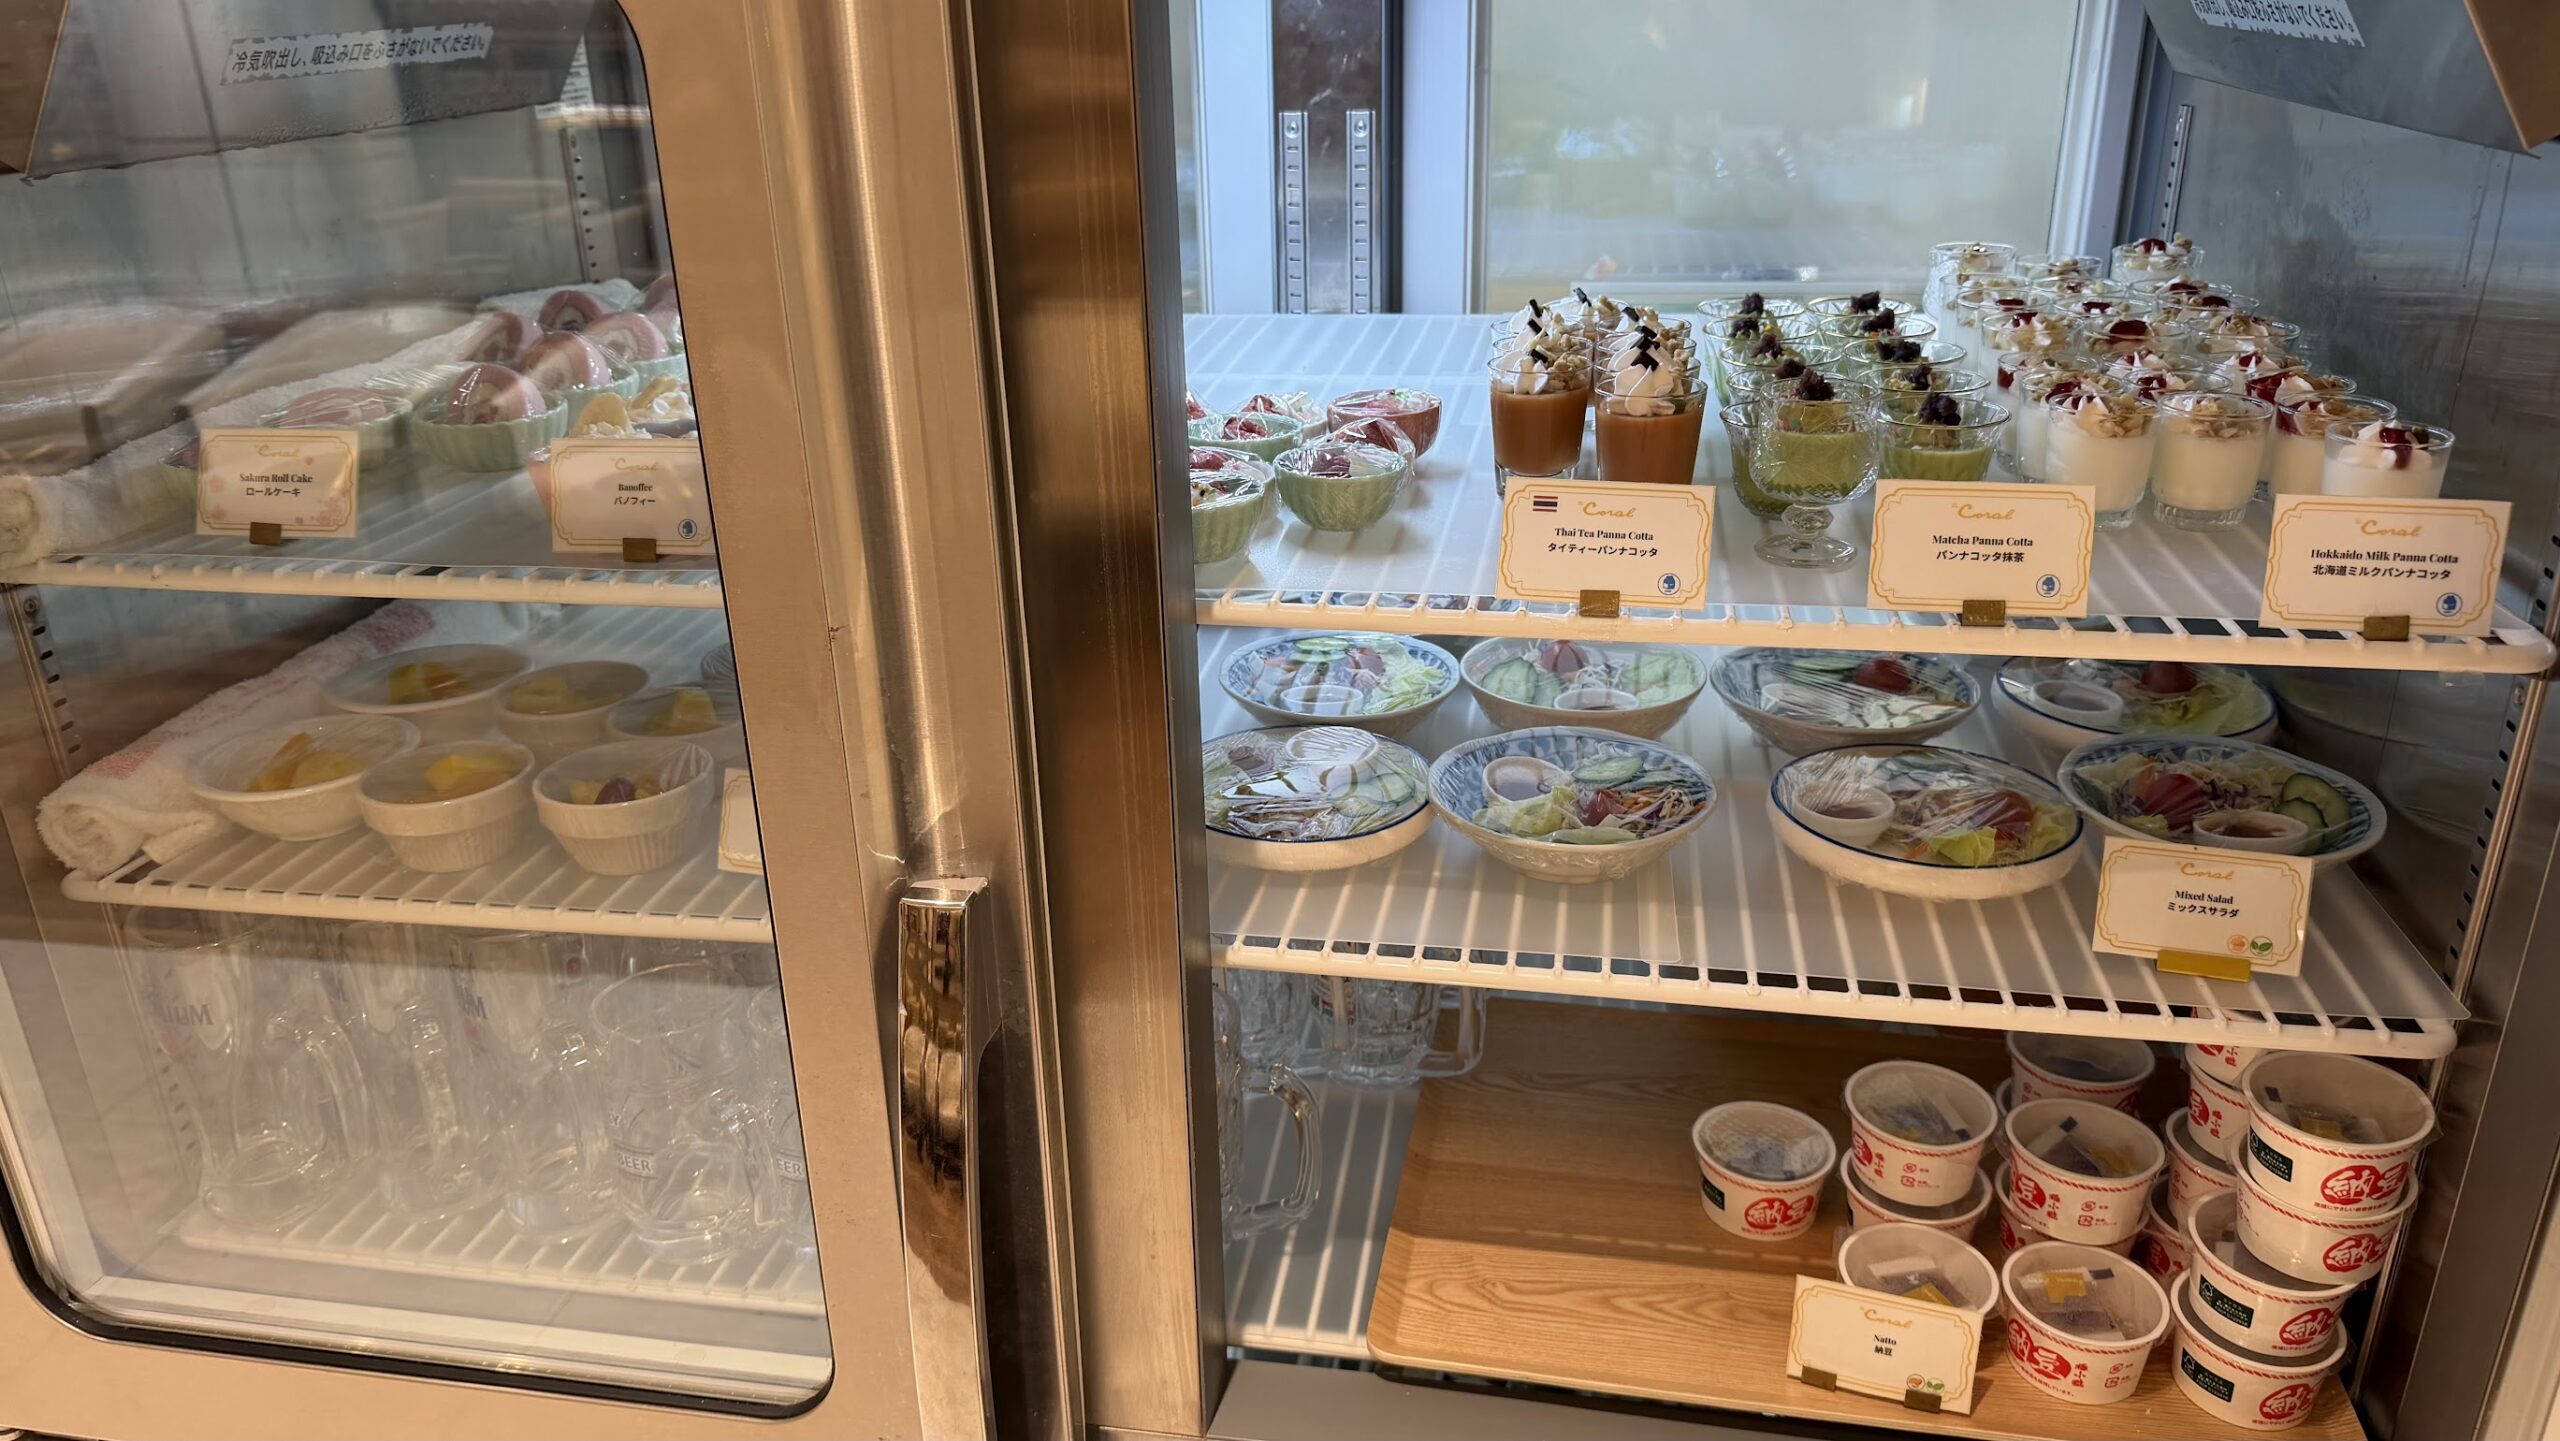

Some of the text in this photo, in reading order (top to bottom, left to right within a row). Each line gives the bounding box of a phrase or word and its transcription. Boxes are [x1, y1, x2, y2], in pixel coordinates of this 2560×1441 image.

[239, 473, 313, 483] Sakura Roll Cake
[246, 487, 301, 497] ロールケーキ
[618, 483, 653, 492] Banoffee
[614, 496, 656, 506] バノフィー
[1582, 501, 1637, 518] Coral
[1957, 503, 2016, 520] Coral
[1554, 527, 1654, 541] Thai Tea Panna Cotta
[2360, 520, 2423, 537] Coral
[1932, 534, 2033, 547] Matcha Panna Cotta
[1548, 542, 1658, 557] タイティーパンナコッタ
[1936, 550, 2025, 563] パンナコッタ抹茶
[2310, 549, 2459, 564] Hokkaido Milk Panna Cotta
[2312, 564, 2451, 580] 北海道ミルクパンナコッタ
[2174, 890, 2234, 905] Mixed Salad
[2167, 902, 2240, 918] ミックスサラダ
[775, 1158, 803, 1176] EER
[1873, 1334, 1897, 1346] Natto
